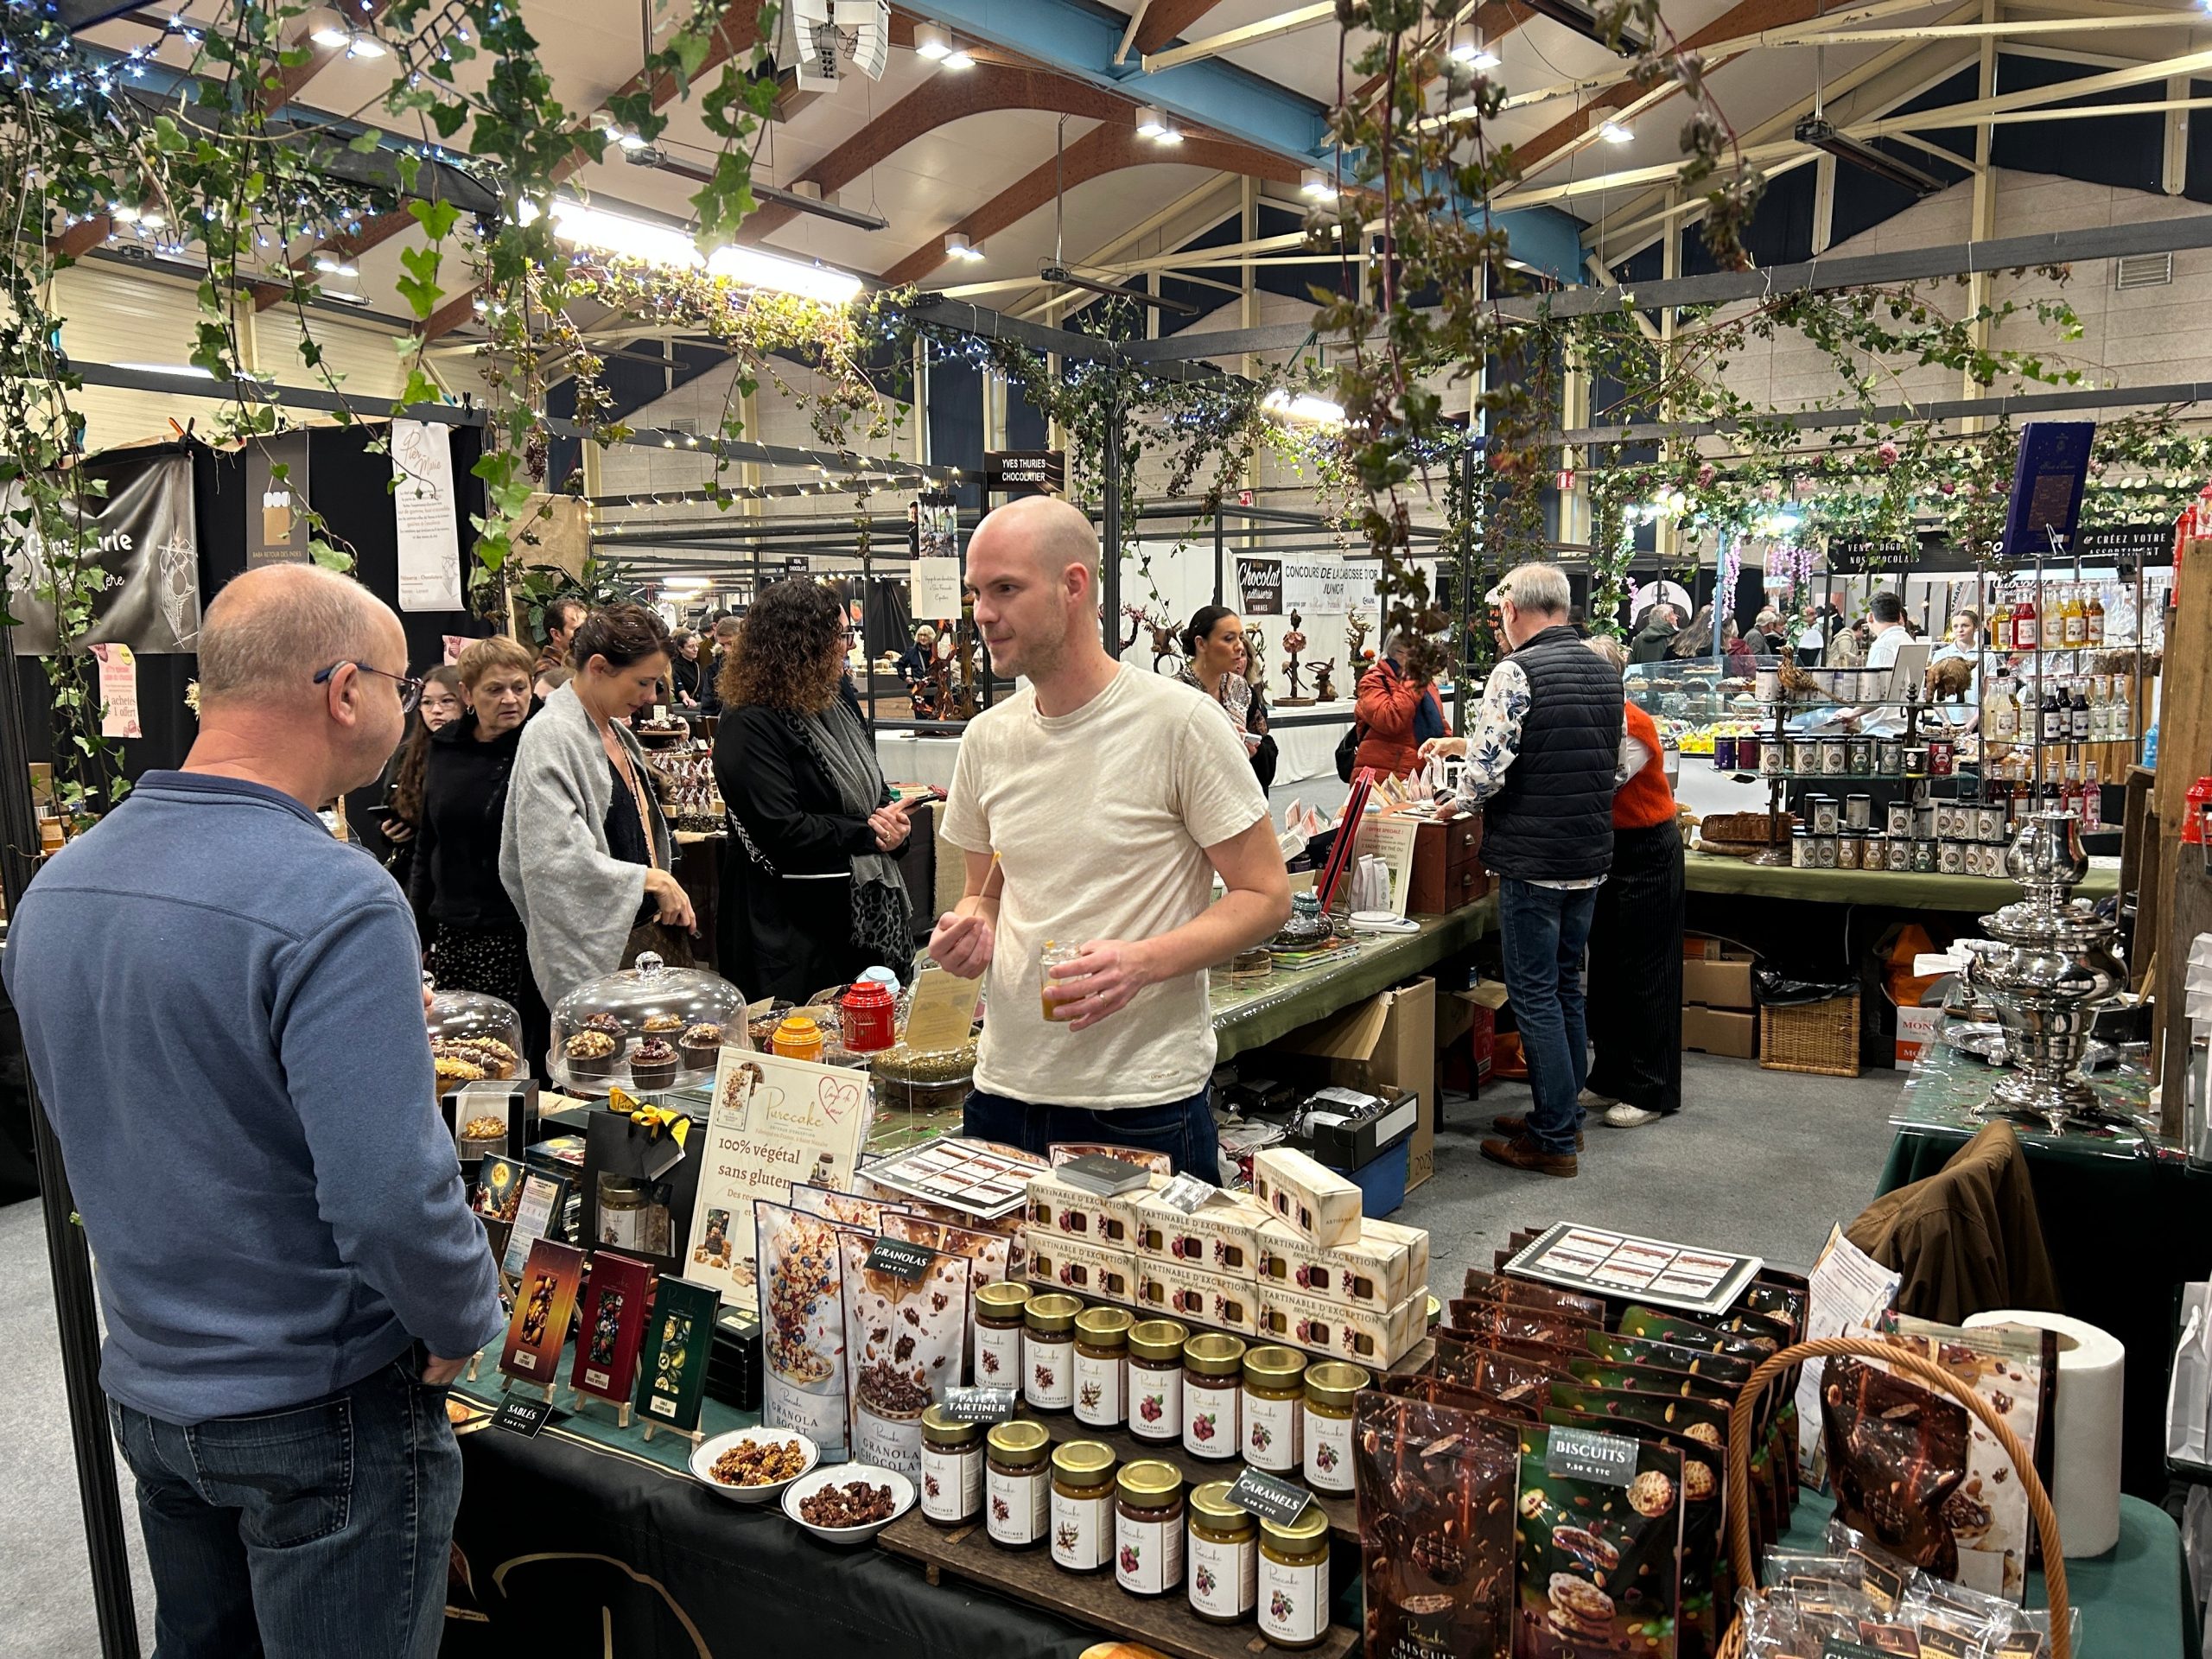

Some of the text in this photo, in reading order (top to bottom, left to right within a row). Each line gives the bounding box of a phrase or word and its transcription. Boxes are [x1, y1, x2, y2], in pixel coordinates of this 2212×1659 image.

[1002, 459, 1046, 467] YVES THURIES
[1002, 472, 1045, 481] CHOCOLATIER
[2083, 532, 2166, 544] & CRÉEZ VOTRE
[1850, 556, 1866, 564] NOS
[1238, 562, 1281, 588] Chocolat
[1285, 565, 1319, 579] CONCOURS
[1321, 568, 1332, 578] DE
[1323, 582, 1344, 594] JUNIOR
[119, 706, 137, 717] offert
[754, 1085, 823, 1128] Purecake
[719, 1137, 801, 1165] 100% végétal
[718, 1164, 792, 1190] sans gluten
[727, 1188, 741, 1199] Des
[1032, 1185, 1128, 1211] TARTINABLE D'EXCEPTION
[1141, 1210, 1249, 1236] TARTINABLE D'EXCEPTION
[874, 1246, 928, 1267] GRANOLAS
[1033, 1238, 1129, 1266] TARTINABLE D'EXCEPTION
[1262, 1236, 1379, 1268] TARTINABLE D'EXCEPTION
[1142, 1262, 1249, 1293] TARTINABLE D'EXCEPTION
[1263, 1290, 1380, 1325] TARTINABLE D'EXCEPTION
[507, 1403, 537, 1421] SABLÉS
[772, 1401, 818, 1427] GRANOLA
[948, 1402, 1006, 1413] TARTINER
[776, 1415, 809, 1435] BOOST
[862, 1437, 919, 1459] GRANOLA
[1555, 1440, 1625, 1463] BISCUITS
[1595, 1467, 1611, 1476] TTC
[1239, 1479, 1300, 1510] CARAMELS
[1264, 1506, 1276, 1515] TTC
[1399, 1615, 1445, 1645] Purecake
